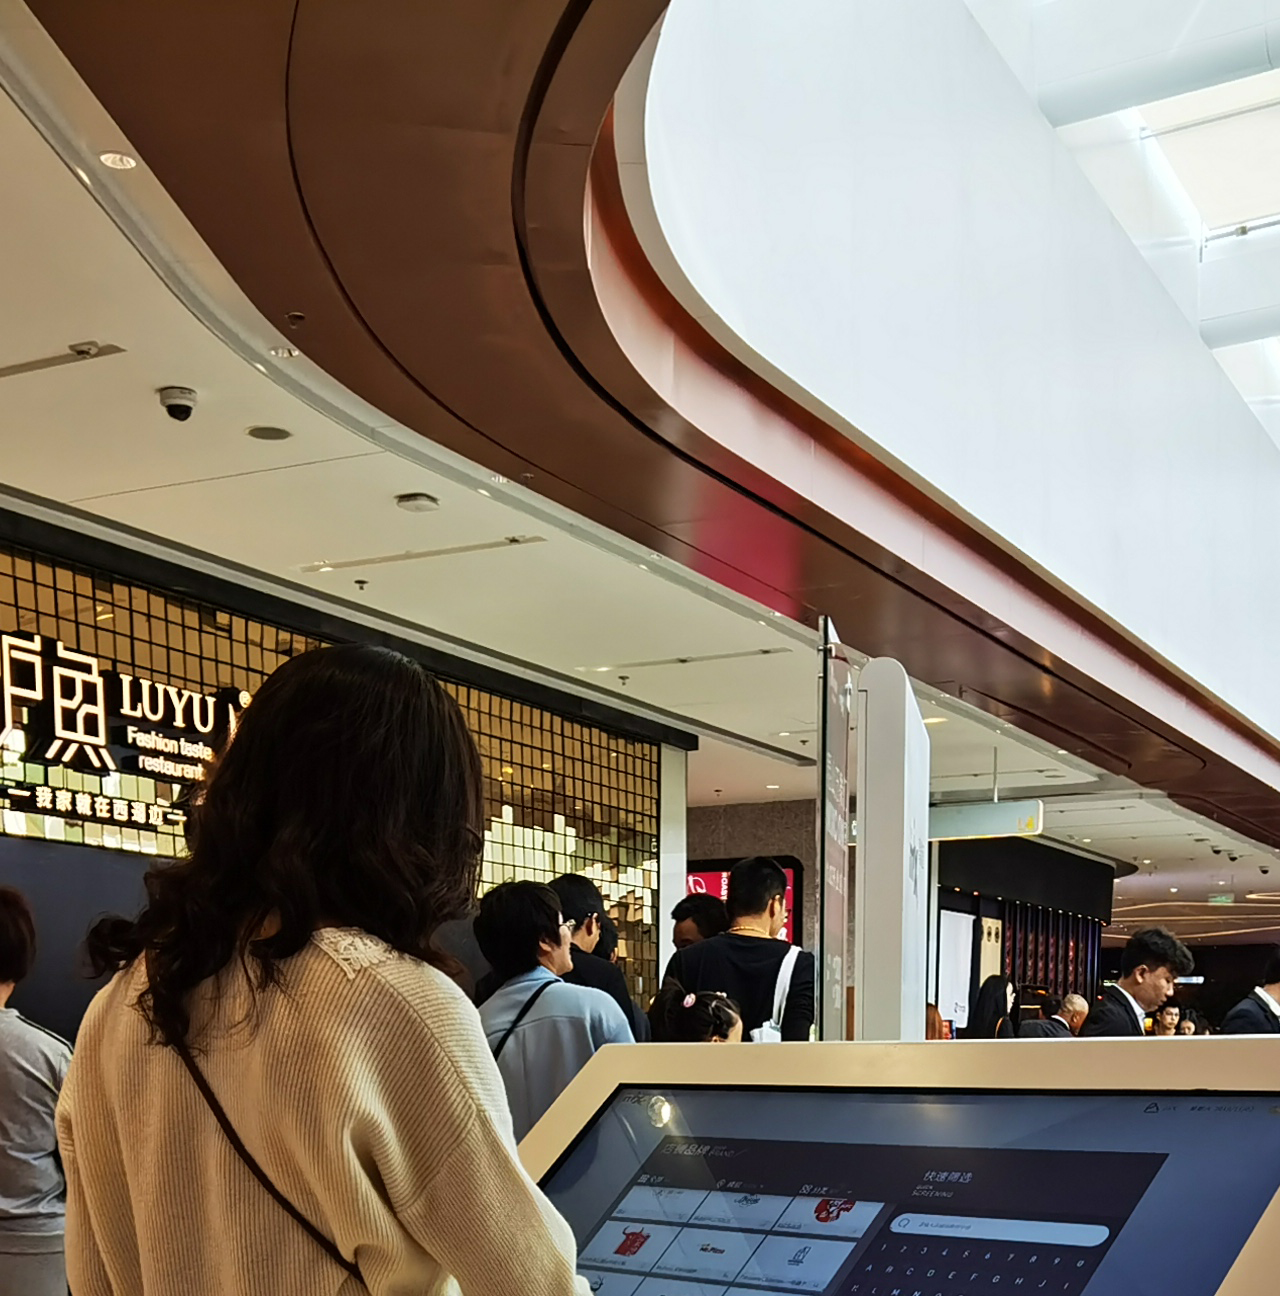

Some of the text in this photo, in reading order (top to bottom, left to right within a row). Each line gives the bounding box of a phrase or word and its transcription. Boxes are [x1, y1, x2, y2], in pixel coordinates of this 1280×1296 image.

[119, 673, 216, 733] LUYU
[127, 725, 213, 760] Fashion taste
[138, 755, 205, 781] restaurant
